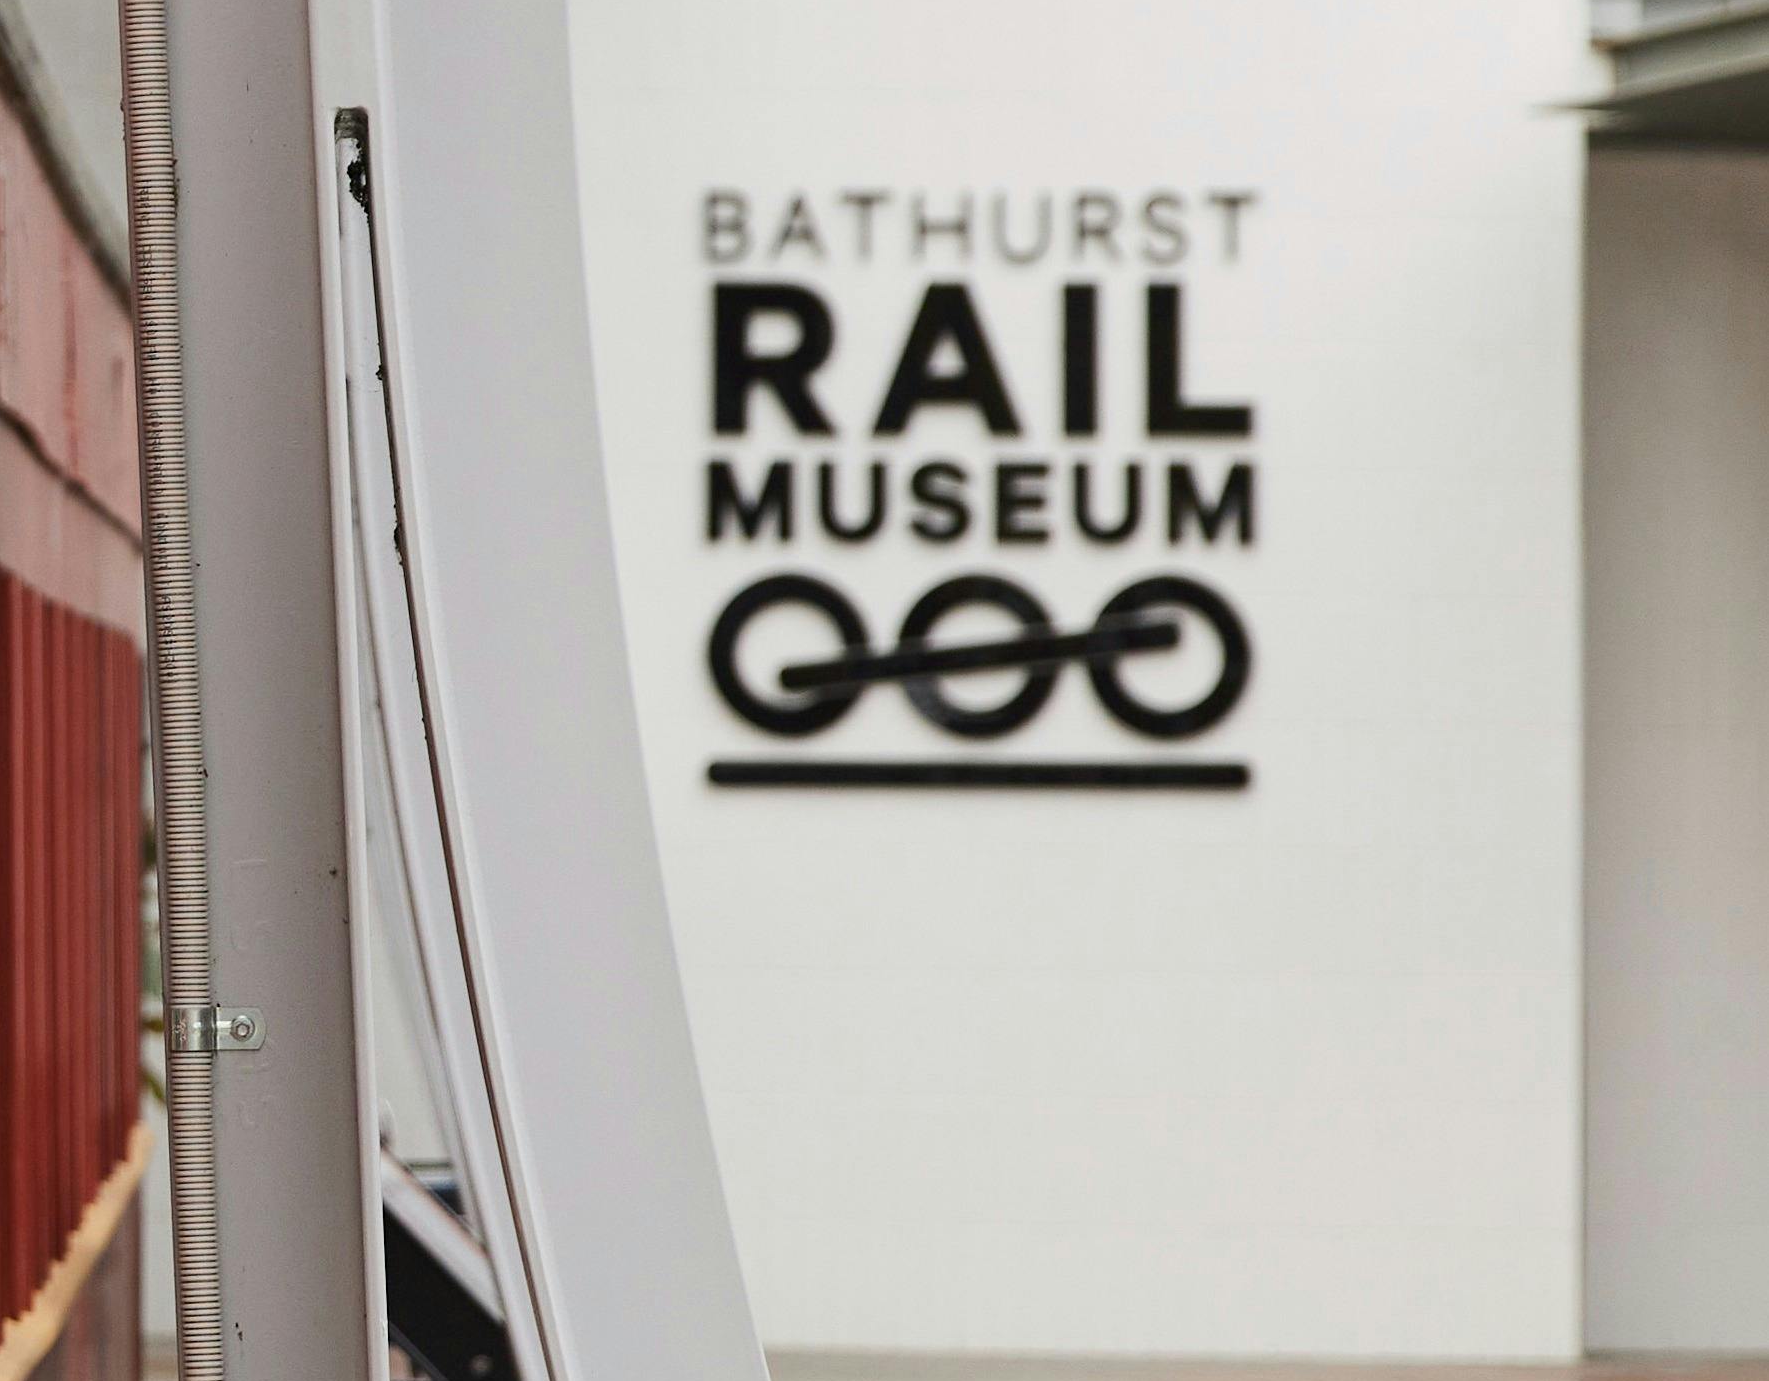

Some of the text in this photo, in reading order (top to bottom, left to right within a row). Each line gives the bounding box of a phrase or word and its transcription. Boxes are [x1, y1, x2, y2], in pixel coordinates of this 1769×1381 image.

[701, 188, 1256, 268] BATHURST
[712, 280, 1253, 438] RAIL
[706, 458, 1256, 546] MUSEUM
